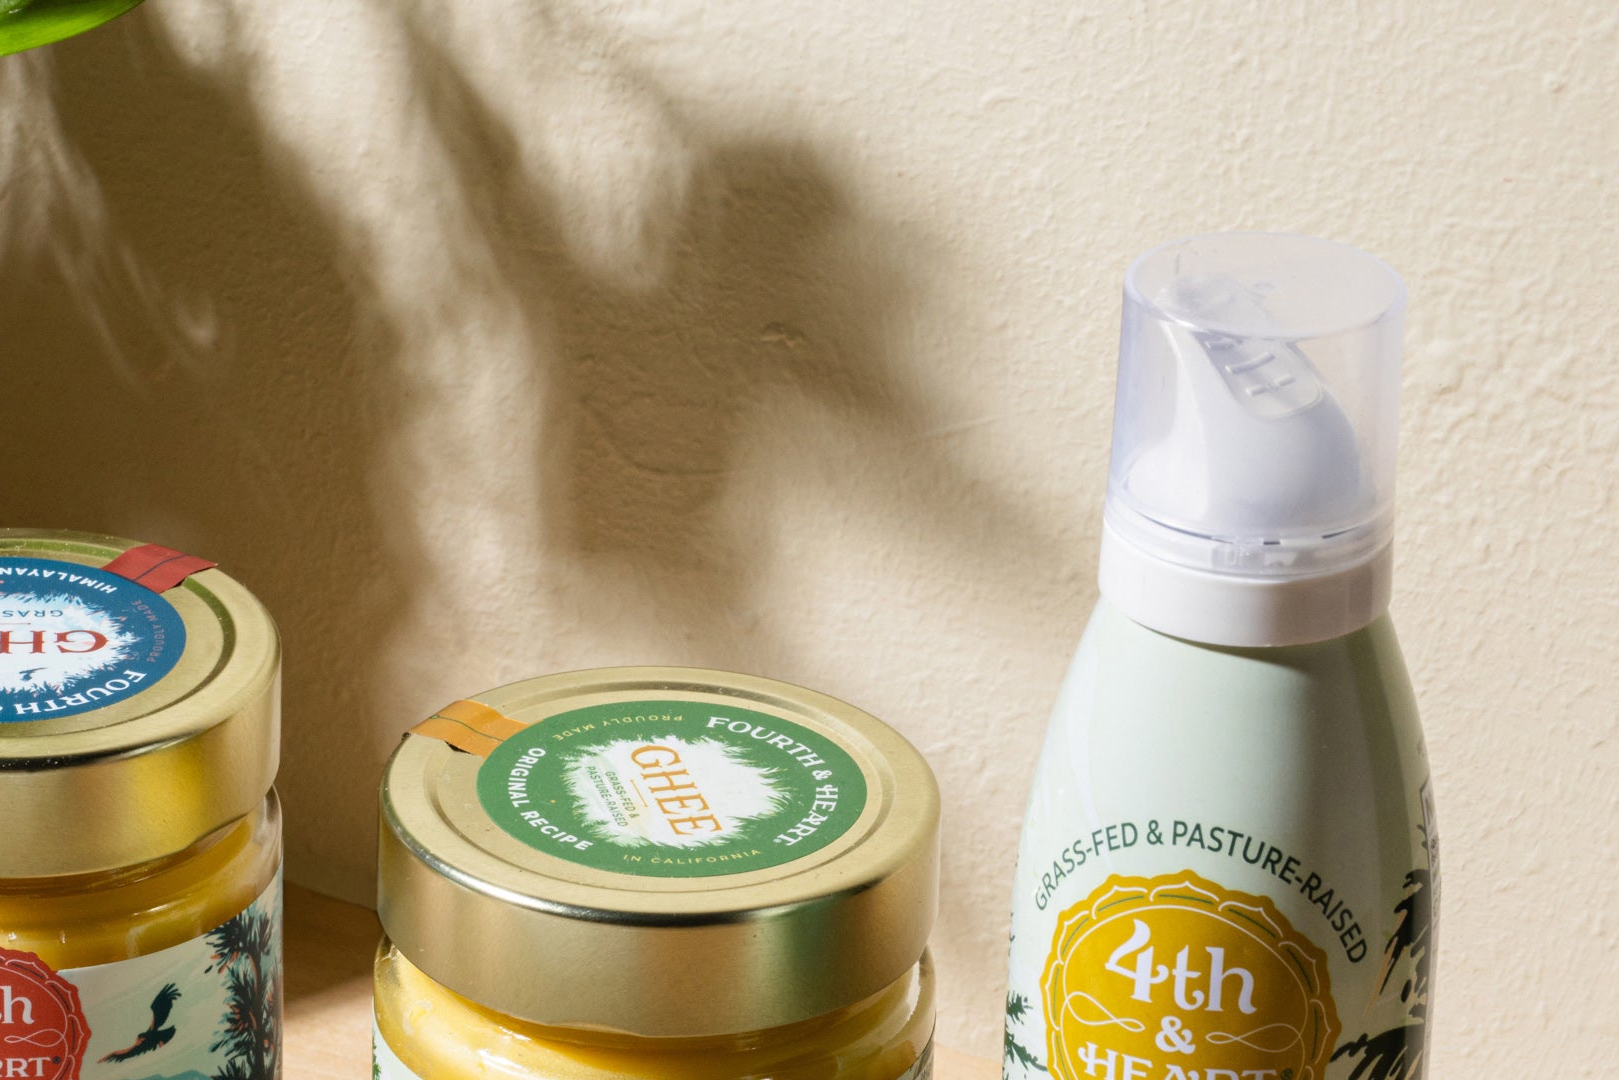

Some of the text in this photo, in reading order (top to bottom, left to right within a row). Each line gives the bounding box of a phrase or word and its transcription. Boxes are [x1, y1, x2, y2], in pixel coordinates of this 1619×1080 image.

[13, 669, 147, 714] FOURTH
[706, 716, 825, 768] FOURTH
[508, 747, 594, 850] ORIGINAL RECIPE
[631, 745, 723, 835] GHEE
[622, 850, 761, 864] IN CALIFORNIA
[1036, 822, 1138, 911] GRASS-FED
[1172, 820, 1368, 964] PASTURE-RAISED
[1105, 919, 1257, 1014] 4th
[1155, 1016, 1196, 1053] &
